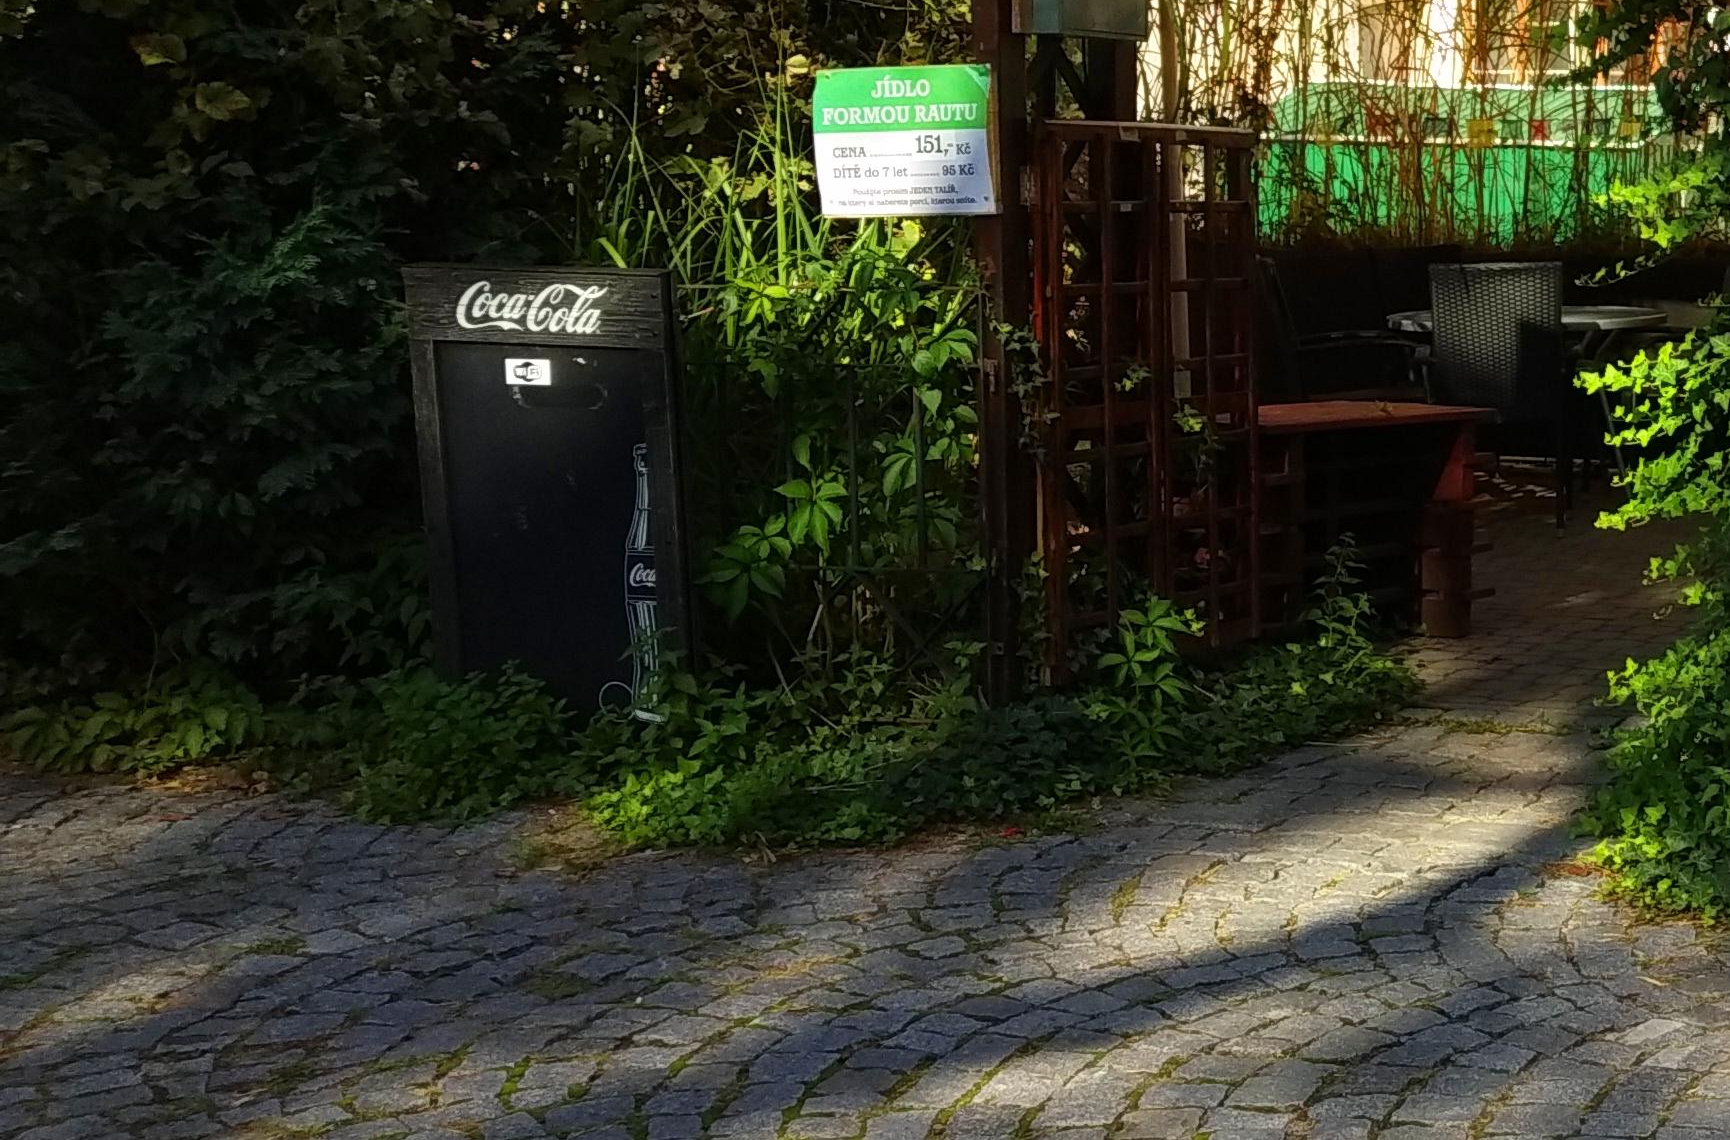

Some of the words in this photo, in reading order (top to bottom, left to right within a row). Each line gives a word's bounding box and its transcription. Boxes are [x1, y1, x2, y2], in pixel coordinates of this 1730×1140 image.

[871, 74, 931, 98] JÍDLO
[821, 105, 910, 126] FORMOU
[914, 102, 978, 123] RAUTU
[833, 146, 867, 159] CENA
[956, 141, 972, 155] Kč
[833, 163, 861, 179] DÍTĚ
[864, 166, 880, 178] do
[883, 166, 890, 177] 7
[893, 166, 908, 178] let
[942, 164, 956, 177] 95
[959, 163, 975, 176] Kč
[456, 281, 609, 335] Coca-Cola
